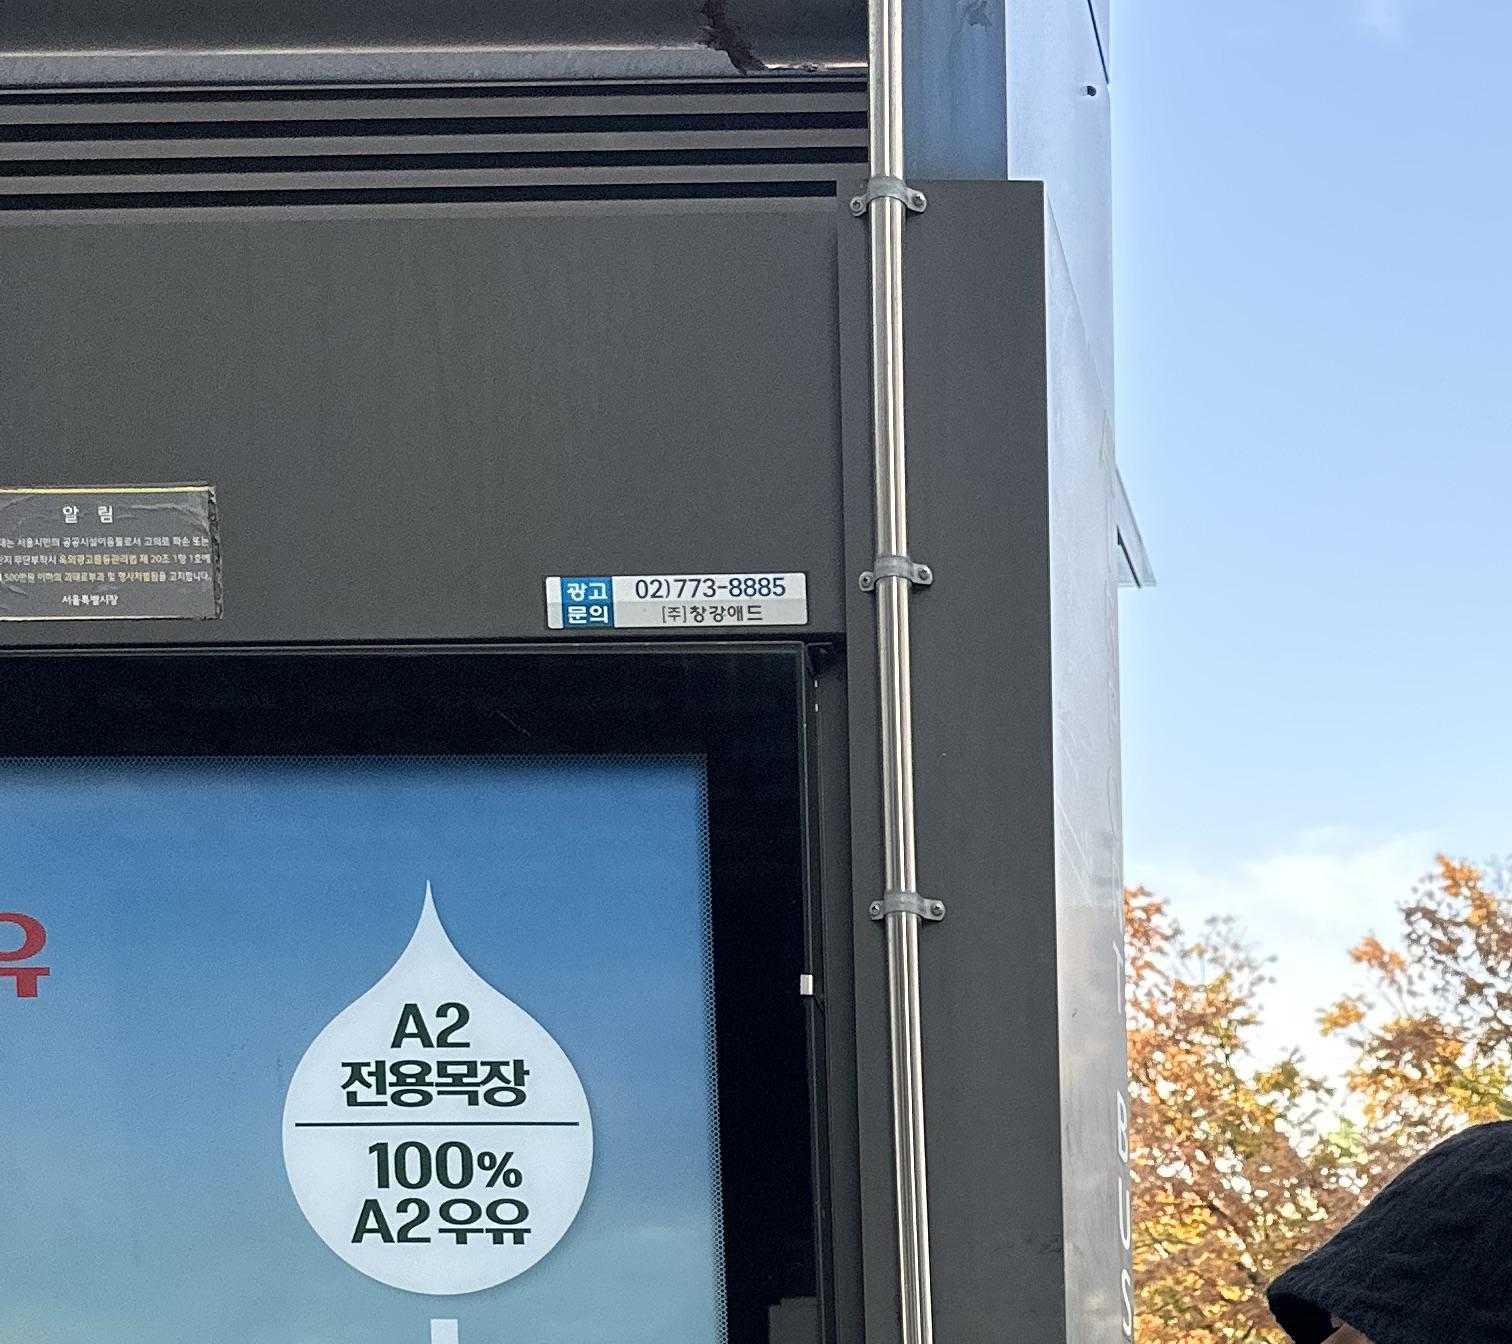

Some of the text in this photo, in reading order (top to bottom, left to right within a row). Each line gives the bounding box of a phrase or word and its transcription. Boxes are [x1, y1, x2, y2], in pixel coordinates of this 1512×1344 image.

[62, 594, 118, 606] 서울특별시장
[566, 583, 608, 601] 광고
[635, 577, 786, 599] 02)773-8885
[567, 605, 609, 624] 문의
[391, 1002, 471, 1048] A2
[341, 1059, 530, 1107] 전용목장
[369, 1141, 523, 1189] 100%
[351, 1198, 532, 1245] A2우유
[1117, 1089, 1132, 1338] BUS
